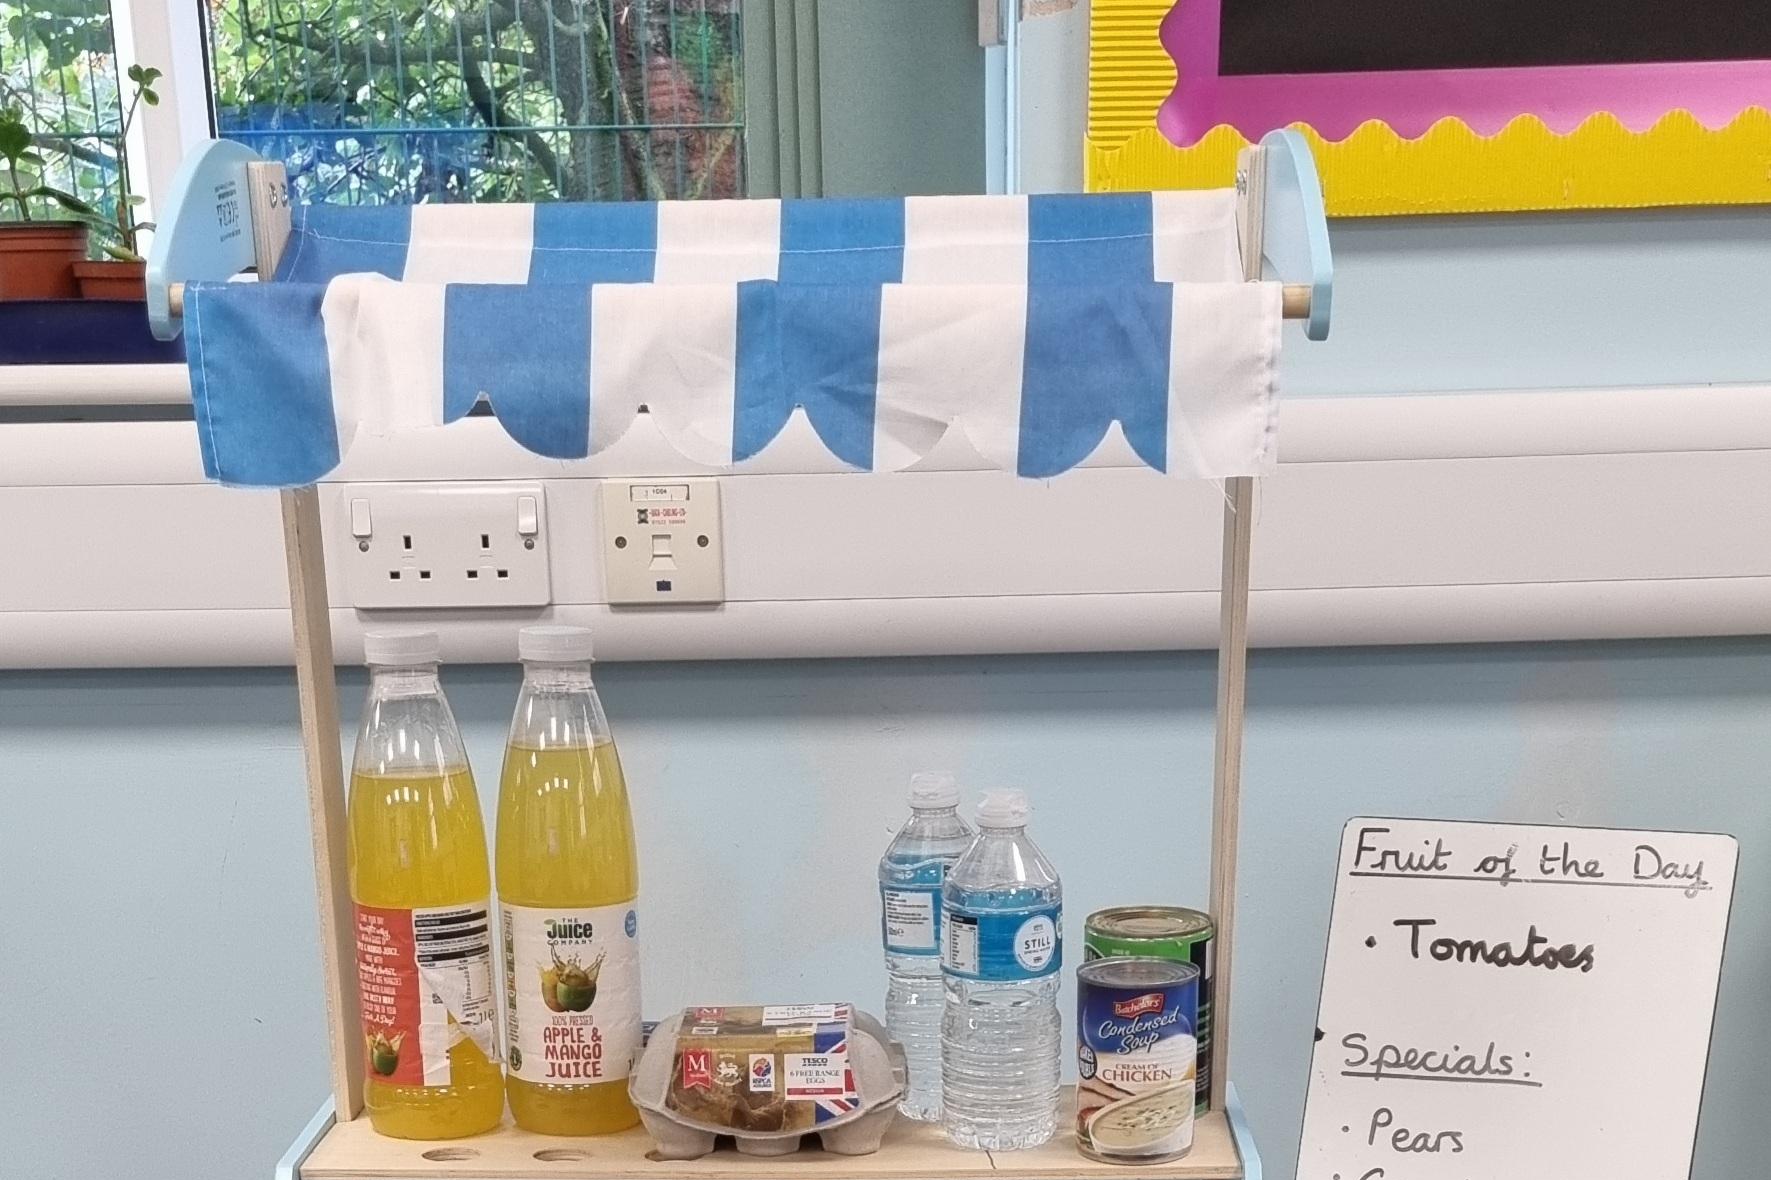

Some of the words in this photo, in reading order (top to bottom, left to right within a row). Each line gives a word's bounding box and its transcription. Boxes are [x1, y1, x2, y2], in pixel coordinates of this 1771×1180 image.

[1353, 827, 1452, 871] Fruit
[1474, 843, 1519, 886] of
[1540, 841, 1604, 877] the
[1633, 844, 1708, 898] Day
[546, 921, 593, 939] Juice
[1024, 936, 1050, 950] STILL
[1393, 918, 1594, 972] Tomatoes
[568, 1014, 594, 1026] PRESSED
[1098, 1005, 1180, 1039] Condensed
[543, 1026, 585, 1044] APPLE
[591, 1026, 602, 1043] &
[1117, 1032, 1159, 1055] Soup
[544, 1043, 603, 1061] MANGO
[1341, 1033, 1531, 1081] Specials:
[545, 1060, 603, 1079] JUICE
[687, 1054, 707, 1072] M
[802, 1057, 829, 1066] TESCO
[1115, 1062, 1145, 1071] CREAM
[805, 1077, 826, 1085] EGGS
[815, 1069, 840, 1077] RANGE
[1102, 1067, 1173, 1083] CHICKEN
[1368, 1107, 1463, 1152] Pears
